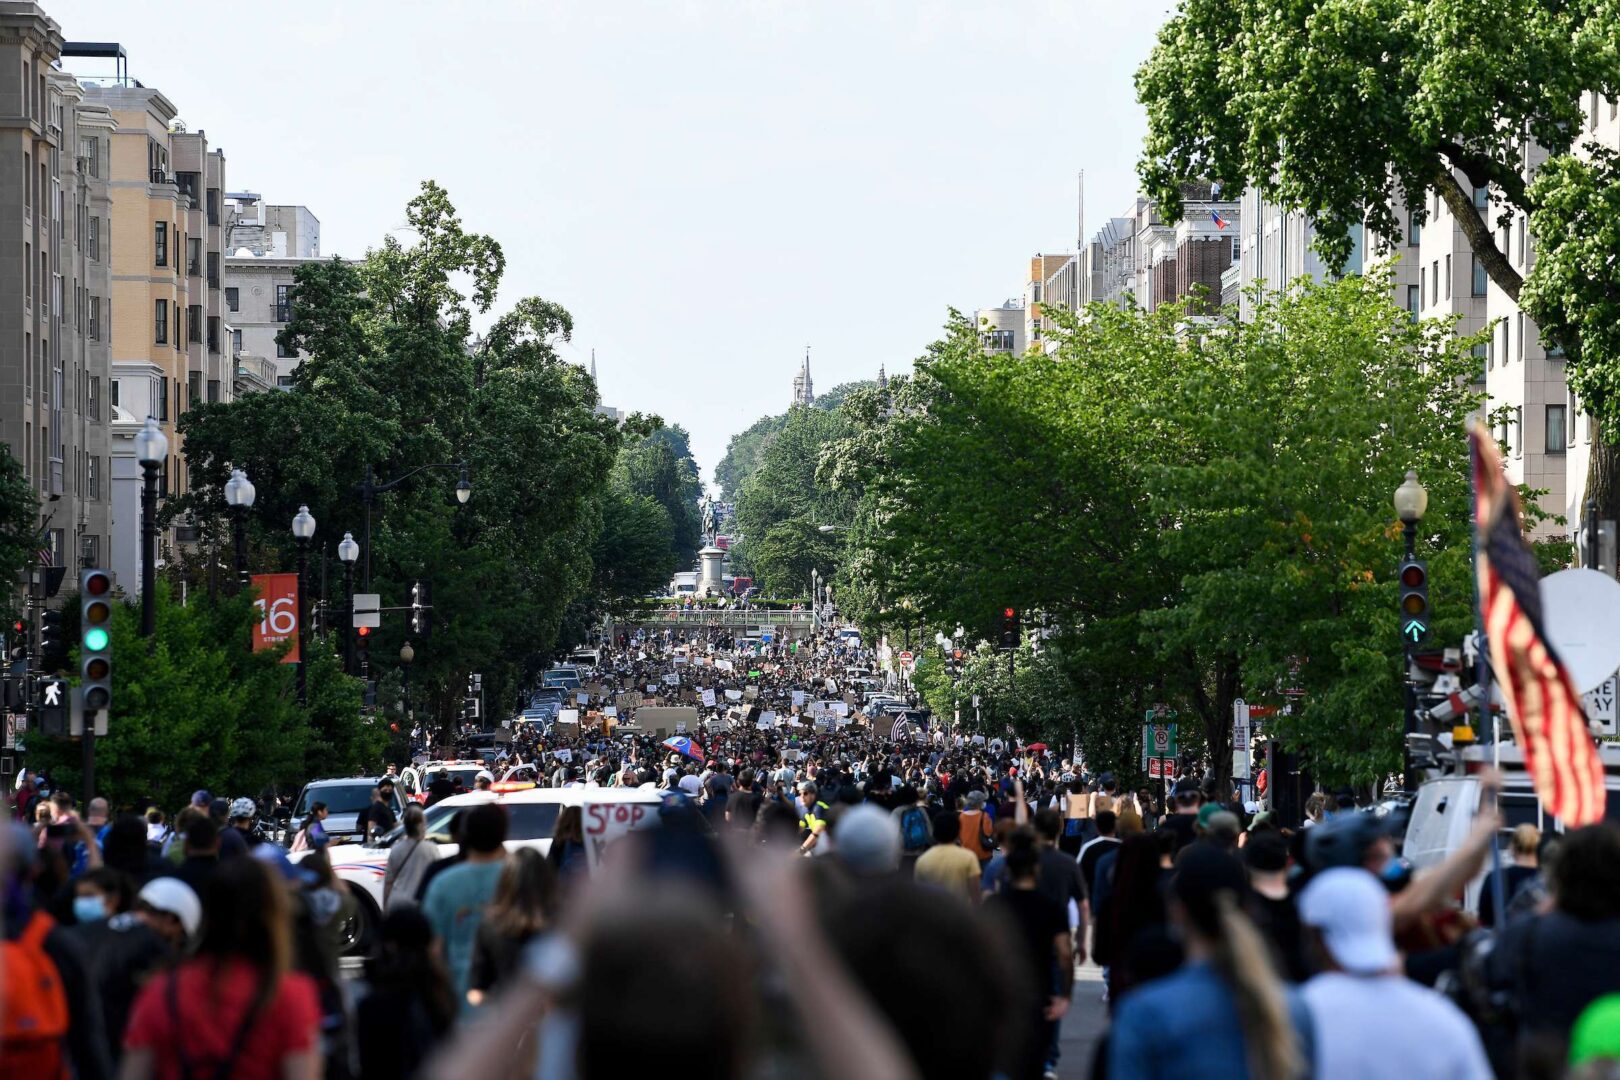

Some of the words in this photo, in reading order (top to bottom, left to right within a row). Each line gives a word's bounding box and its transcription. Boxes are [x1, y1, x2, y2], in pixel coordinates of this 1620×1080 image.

[253, 597, 296, 635] 16
[1589, 681, 1612, 695] NE
[1594, 697, 1613, 711] AY
[586, 802, 644, 834] STOP
